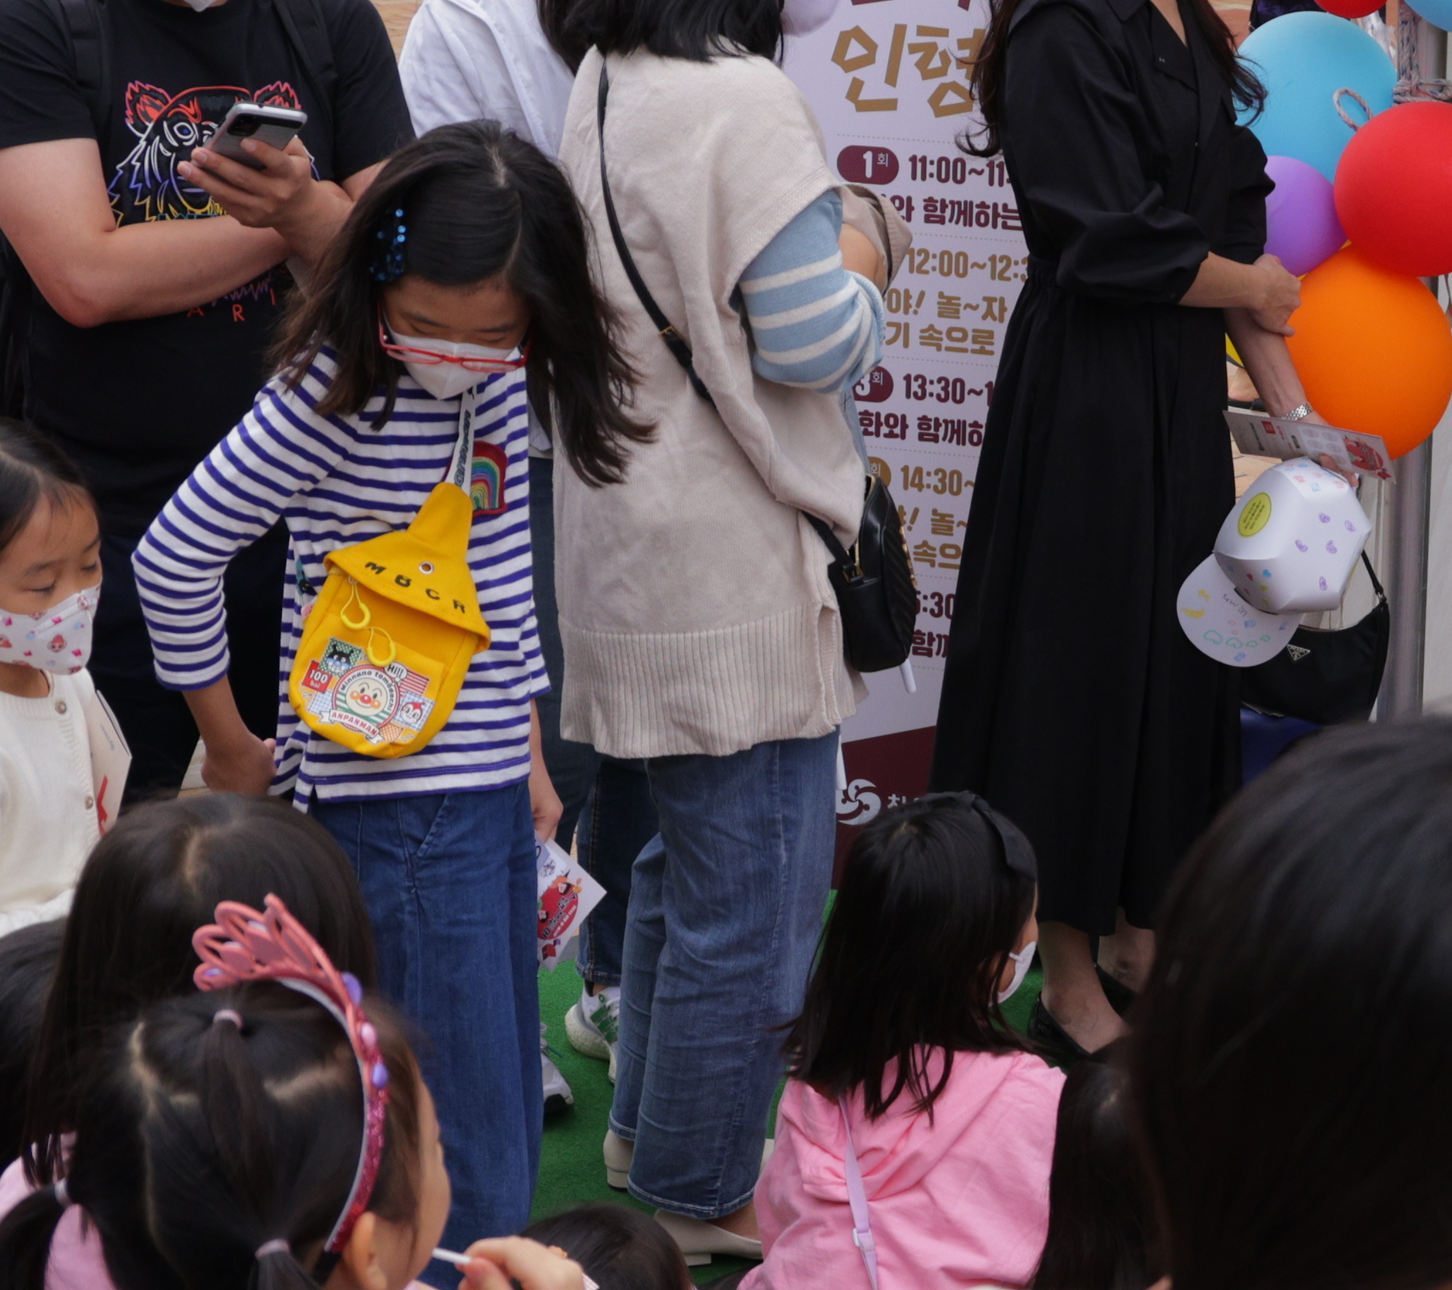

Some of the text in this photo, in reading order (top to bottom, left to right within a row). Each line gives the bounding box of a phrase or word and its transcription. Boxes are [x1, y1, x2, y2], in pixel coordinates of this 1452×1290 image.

[919, 323, 996, 357] 속으로
[902, 372, 995, 408] 13:30~1
[308, 669, 329, 684] 100
[331, 712, 380, 737] ANPANMAN
